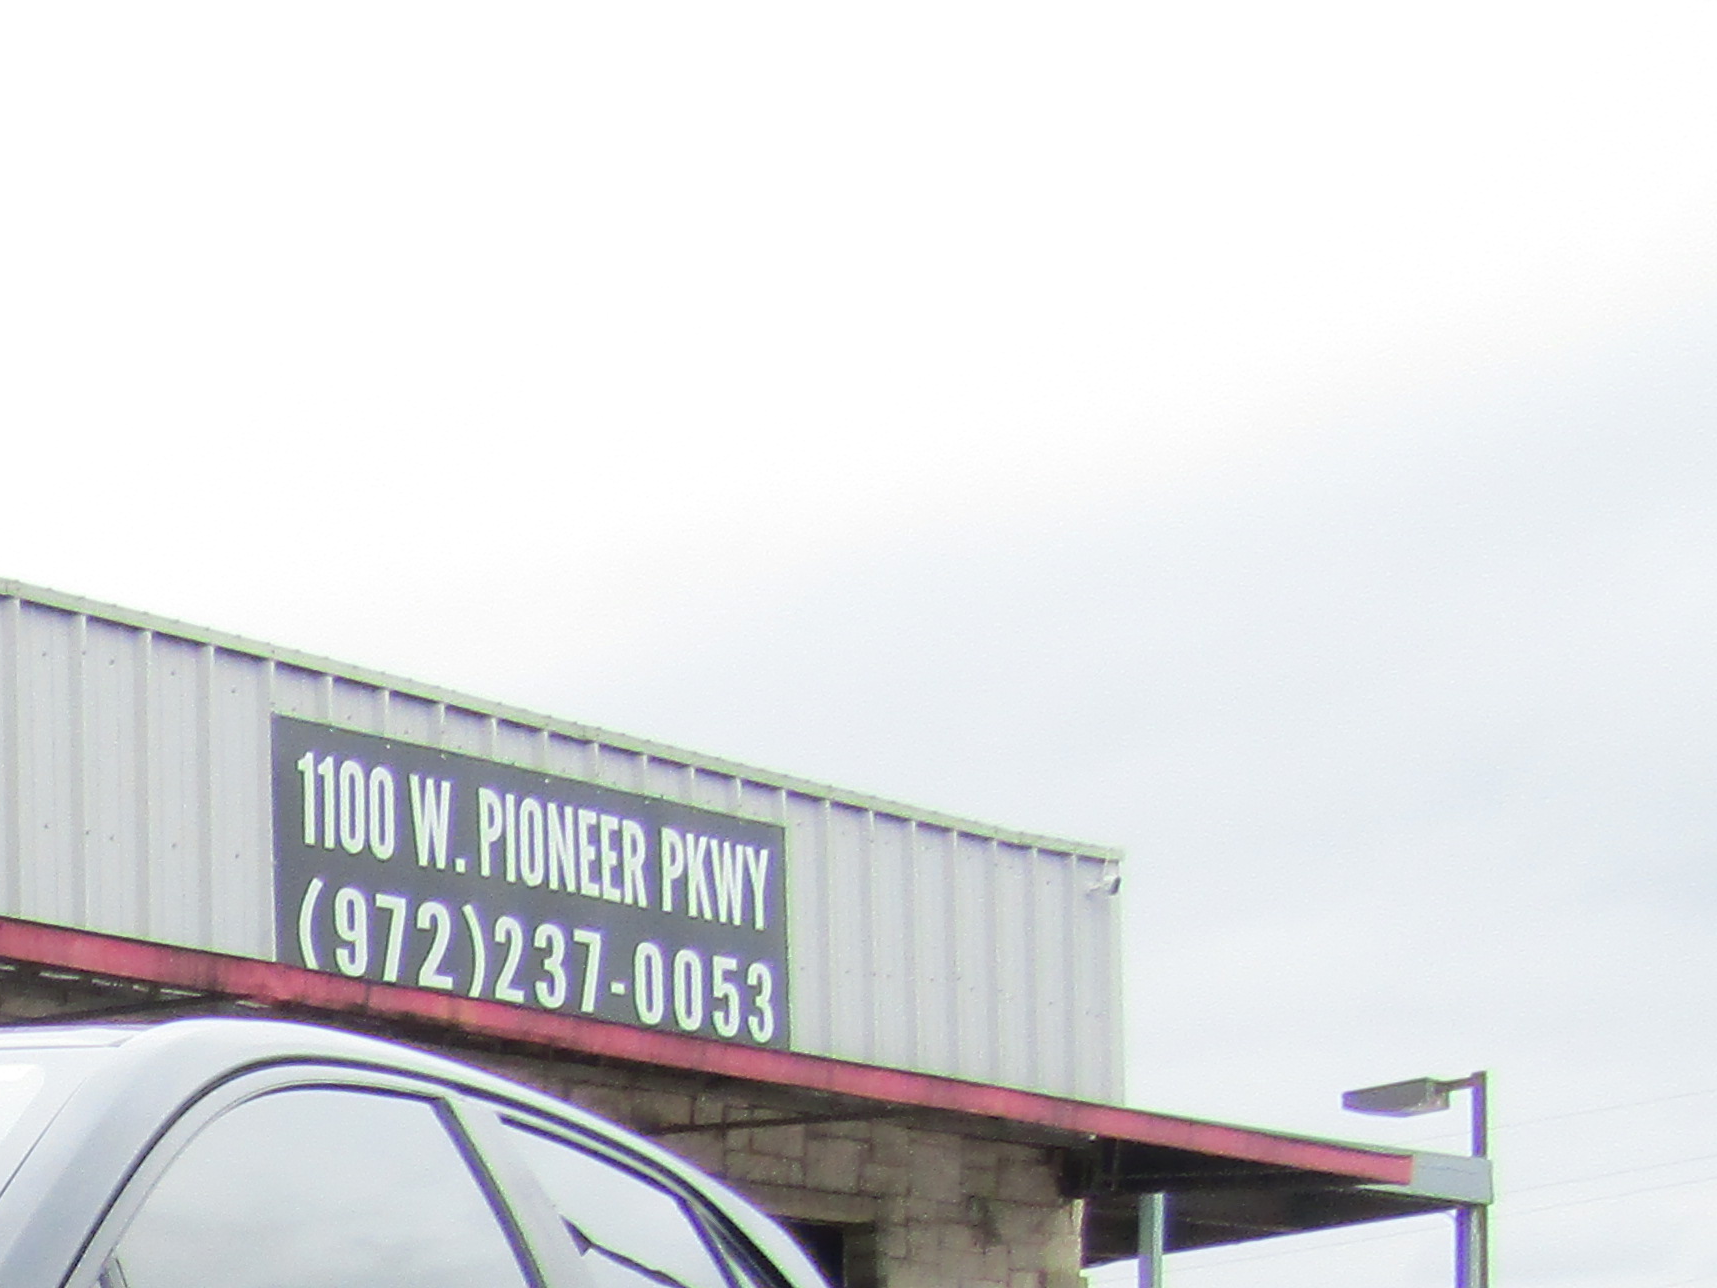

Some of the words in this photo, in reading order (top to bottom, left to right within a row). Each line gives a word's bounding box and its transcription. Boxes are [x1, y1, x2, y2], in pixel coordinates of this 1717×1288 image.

[296, 751, 397, 861] 1100
[408, 773, 466, 874] W.
[477, 786, 649, 909] PIONEER
[660, 826, 770, 932] PKWY
[297, 876, 776, 1044] (972)237-0053
